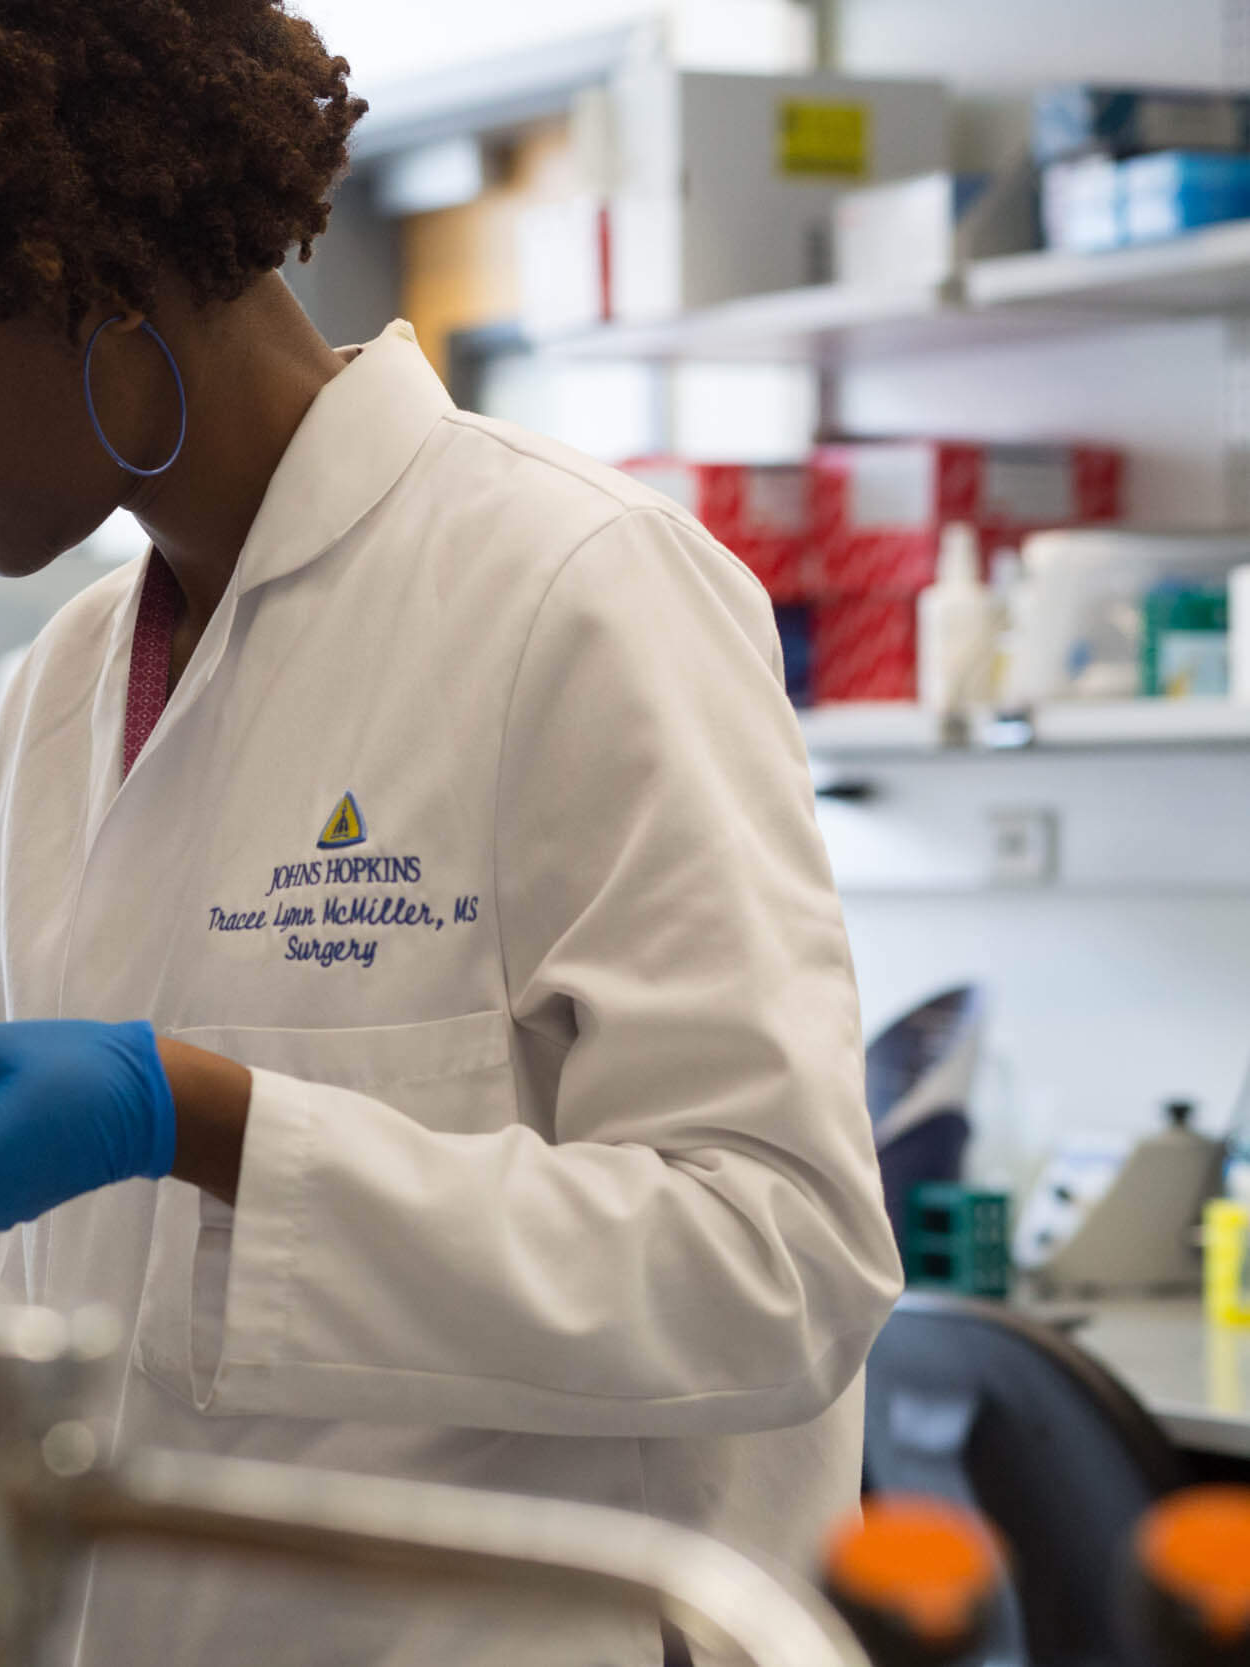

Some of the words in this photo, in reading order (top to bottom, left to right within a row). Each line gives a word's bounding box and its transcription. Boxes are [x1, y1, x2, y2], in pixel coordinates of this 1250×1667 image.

[265, 861, 322, 896] JOHNS
[324, 856, 422, 885] HOPKINS
[208, 906, 266, 931] Tracee
[273, 901, 316, 933] Lynn
[322, 896, 445, 931] McMiller,
[453, 895, 479, 922] MS
[284, 935, 378, 968] Surgery
